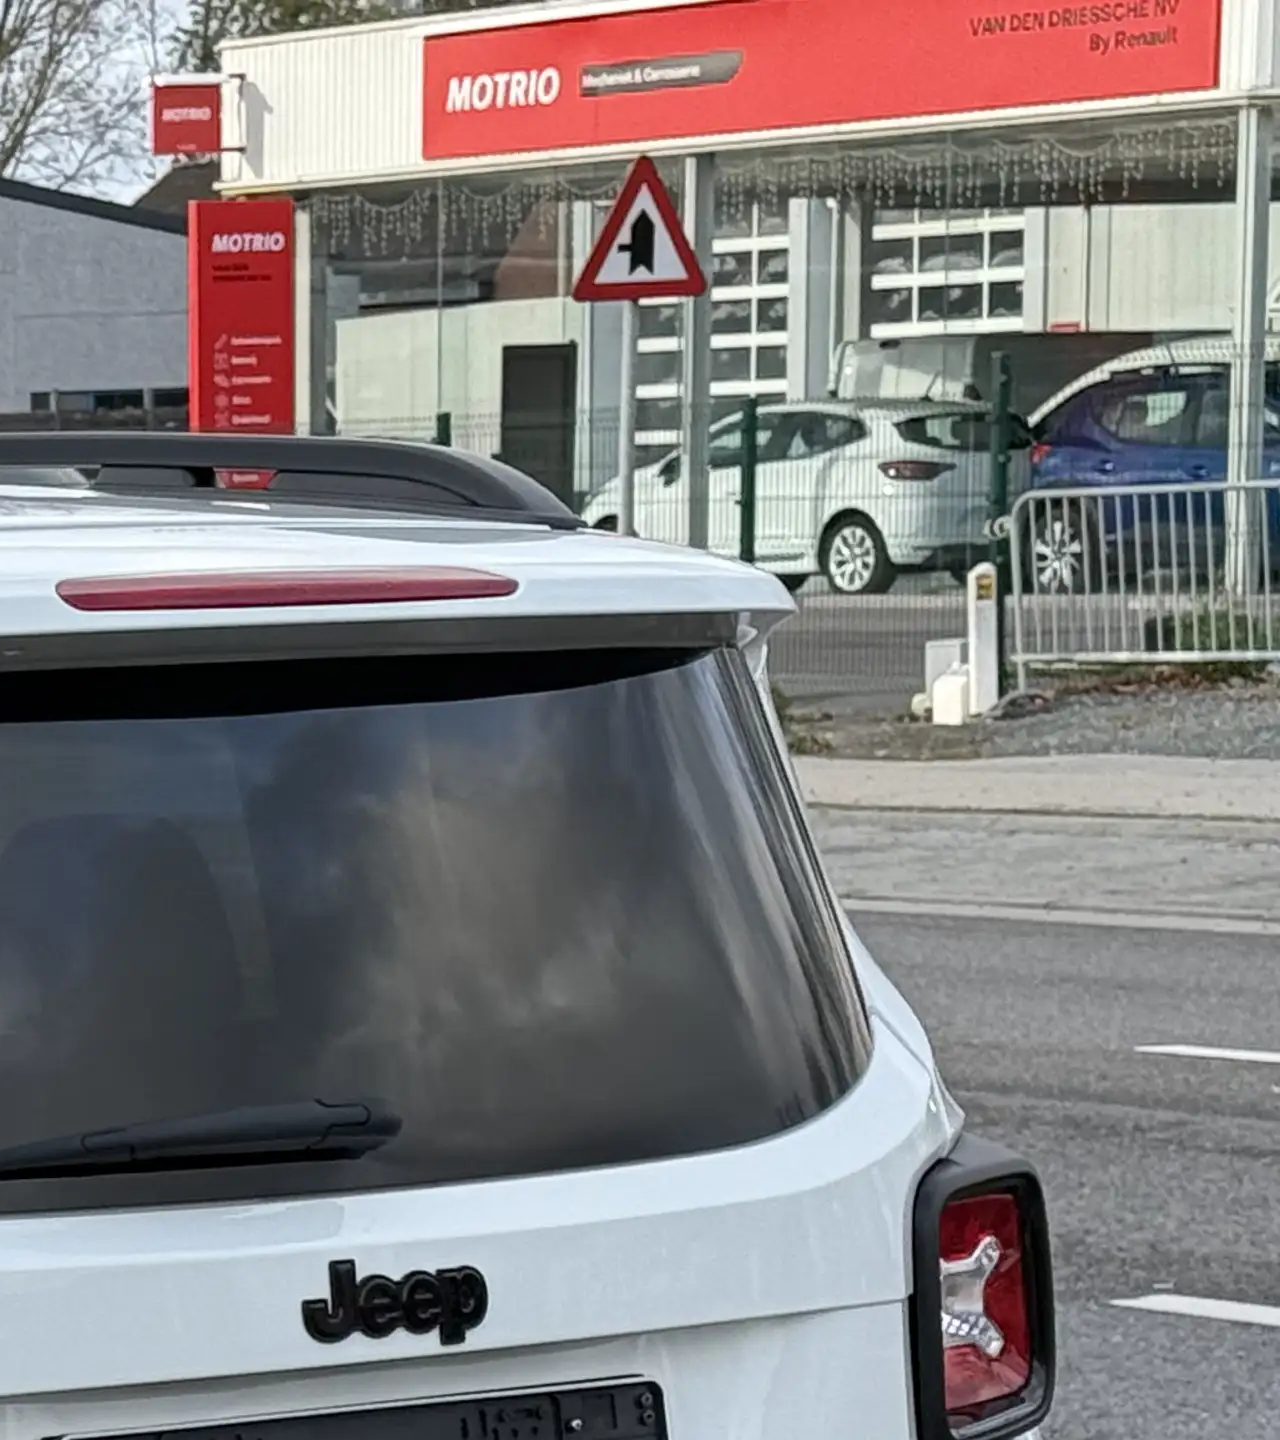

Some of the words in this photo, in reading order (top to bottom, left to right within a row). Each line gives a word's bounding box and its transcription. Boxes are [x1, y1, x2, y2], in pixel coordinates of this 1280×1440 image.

[969, 16, 1006, 37] VAN
[1009, 12, 1044, 32] DEN
[1047, 2, 1149, 28] DRIESSCHE
[1153, 0, 1180, 17] NV
[1089, 32, 1110, 55] By
[1114, 26, 1178, 49] Renault
[445, 66, 561, 113] MOTRIO
[211, 231, 285, 253] MOTRIO
[301, 1259, 489, 1346] Jeep
